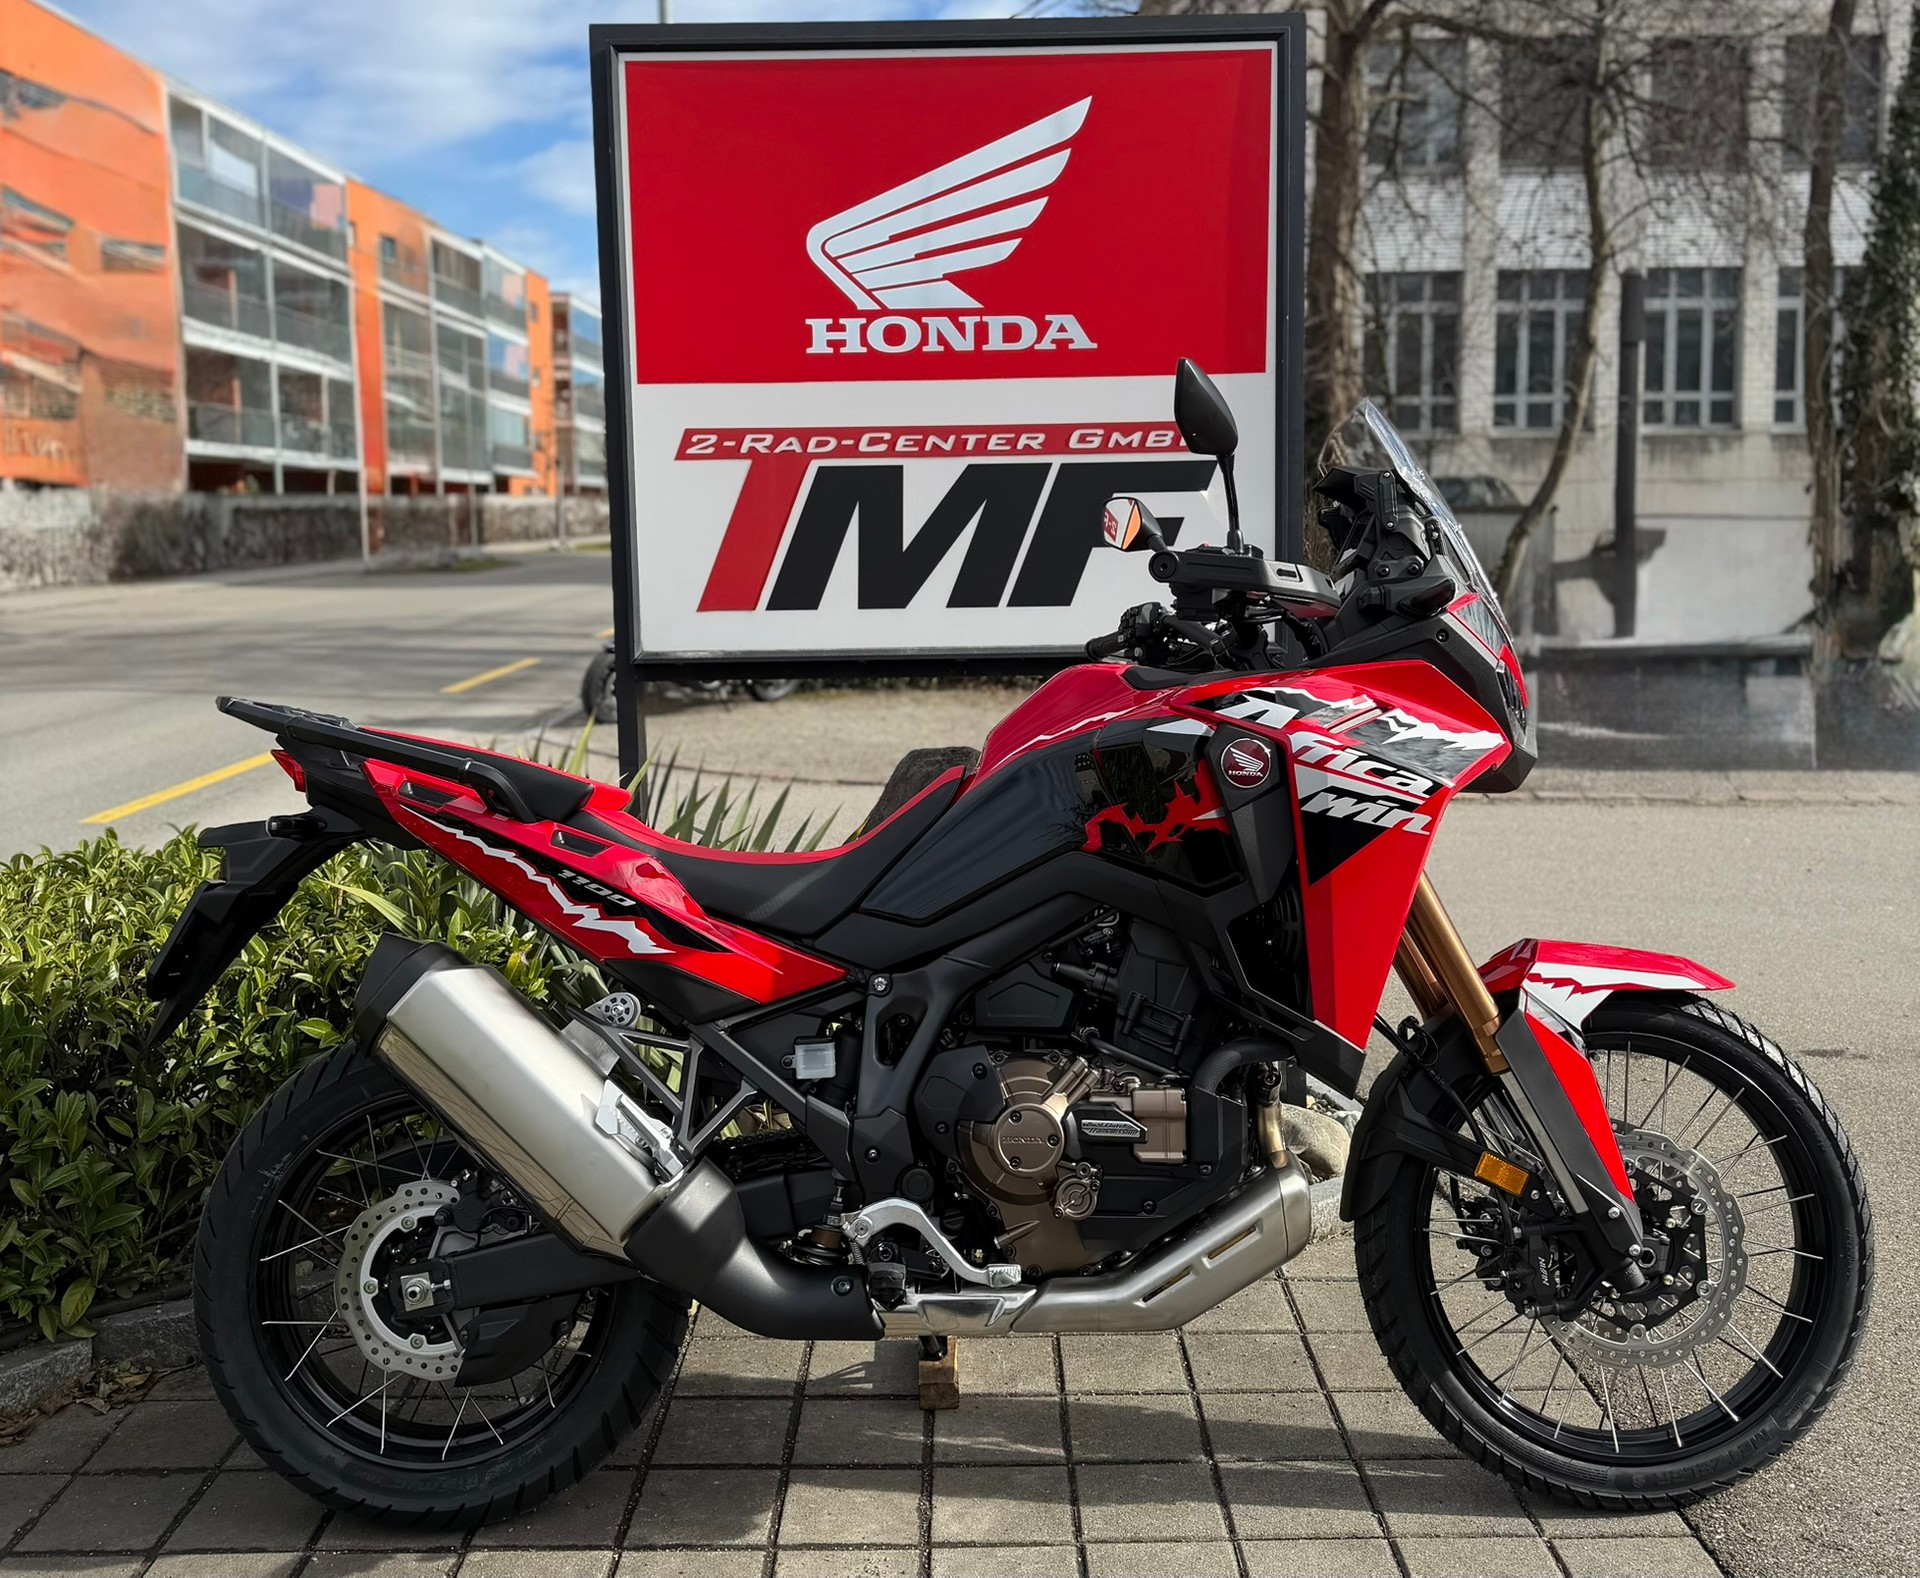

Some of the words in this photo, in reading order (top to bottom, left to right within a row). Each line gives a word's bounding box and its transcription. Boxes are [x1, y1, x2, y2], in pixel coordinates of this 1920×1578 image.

[805, 314, 1098, 355] HONDA
[1068, 429, 1190, 449] GMB
[682, 459, 1218, 612] TMF
[558, 869, 636, 907] 1100
[1002, 1135, 1045, 1145] HONDA
